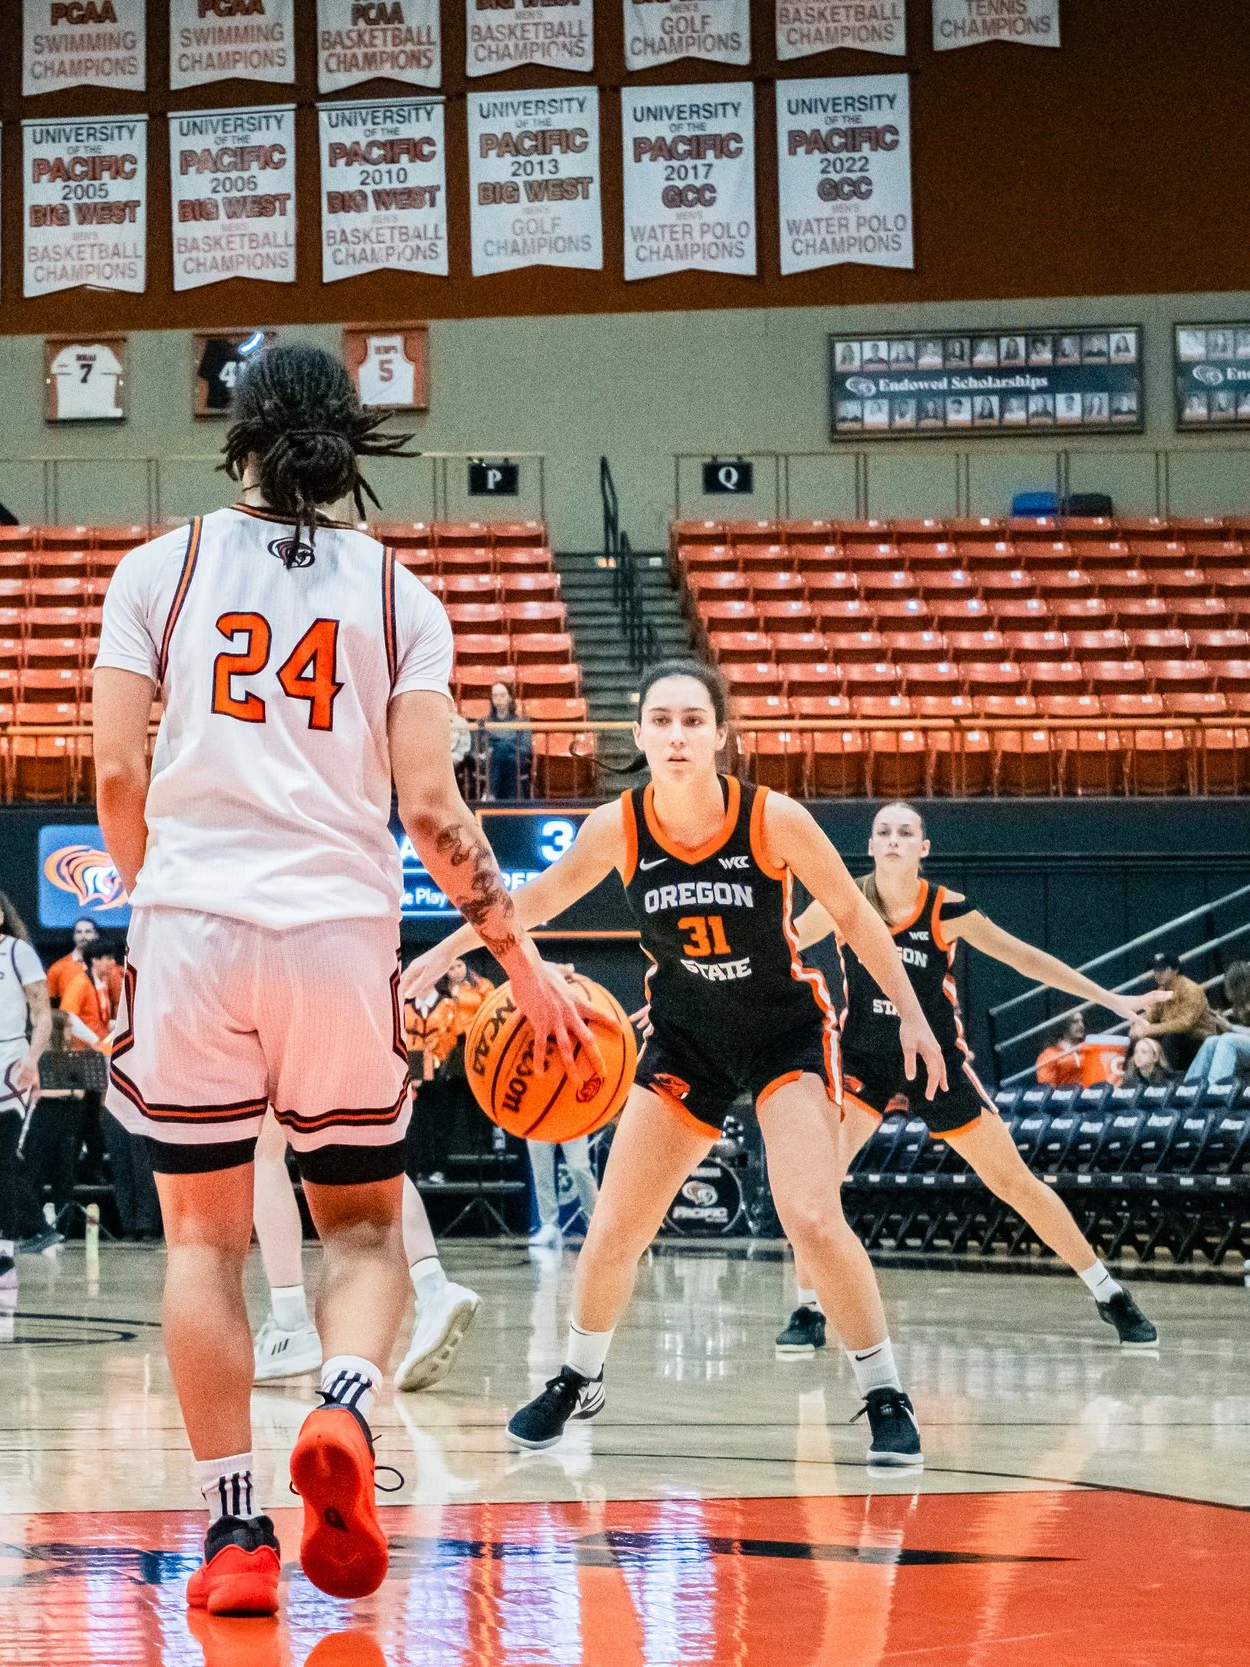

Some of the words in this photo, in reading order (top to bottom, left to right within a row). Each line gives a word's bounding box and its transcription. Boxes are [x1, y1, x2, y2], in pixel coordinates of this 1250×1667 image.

[52, 1, 117, 26] PCAA
[351, 2, 404, 26] PCAA
[778, 5, 902, 26] BASKETBALL
[967, 0, 1028, 16] TENNIS
[471, 22, 588, 45] BASKETBALL
[661, 14, 711, 36] GOLF
[786, 23, 895, 46] CHAMPIONS
[940, 14, 1051, 39] CHAMPIONS
[474, 40, 586, 64] CHAMPIONS
[630, 32, 741, 57] CHAMPIONS
[479, 98, 587, 120] UNIVERSITY
[633, 102, 742, 124] UNIVERSITY
[787, 94, 897, 116] UNIVERSITY
[179, 114, 284, 137] UNIVERSITY
[328, 107, 434, 129] UNIVERSITY
[32, 124, 137, 145] UNIVERSITY
[479, 128, 589, 158] PACIFIC
[787, 125, 900, 156] PACIFIC
[180, 143, 287, 175] PACIFIC
[329, 137, 437, 168] PACIFIC
[633, 133, 744, 162] PACIFIC
[32, 154, 138, 183] PACIFIC
[359, 168, 408, 186] 2010
[511, 159, 559, 178] 2013
[664, 163, 714, 182] 2017
[820, 157, 870, 175] 2022
[62, 183, 109, 201] 2005
[211, 174, 257, 194] 2006
[477, 181, 520, 205] BIG
[524, 177, 593, 203] WEST
[817, 176, 873, 201] GCC
[178, 197, 218, 222] BIG
[224, 193, 290, 220] WEST
[327, 190, 368, 215] BIG
[373, 185, 441, 211] WEST
[661, 183, 717, 209] GCC
[29, 203, 70, 227] BIG
[76, 200, 140, 225] WEST
[326, 224, 443, 248] BASKETBALL
[511, 217, 561, 236] GOLF
[630, 222, 693, 243] WATER
[700, 220, 750, 240] POLO
[787, 216, 850, 238] WATER
[855, 214, 907, 234] POLO
[177, 231, 293, 254] BASKETBALL
[483, 235, 592, 258] CHAMPIONS
[635, 240, 745, 263] CHAMPIONS
[792, 233, 902, 257] CHAMPIONS
[183, 252, 289, 275] CHAMPIONS
[332, 243, 439, 267] CHAMPIONS
[79, 363, 92, 383] 7
[379, 359, 393, 381] 5
[879, 377, 948, 392] Endowed
[952, 375, 1048, 390] Scholarships
[486, 469, 502, 489] P
[718, 466, 738, 489] Q
[211, 611, 345, 732] 24
[718, 856, 749, 869] WCC
[644, 882, 754, 914] OREGON
[677, 915, 732, 957] 31
[680, 957, 752, 981] STATE
